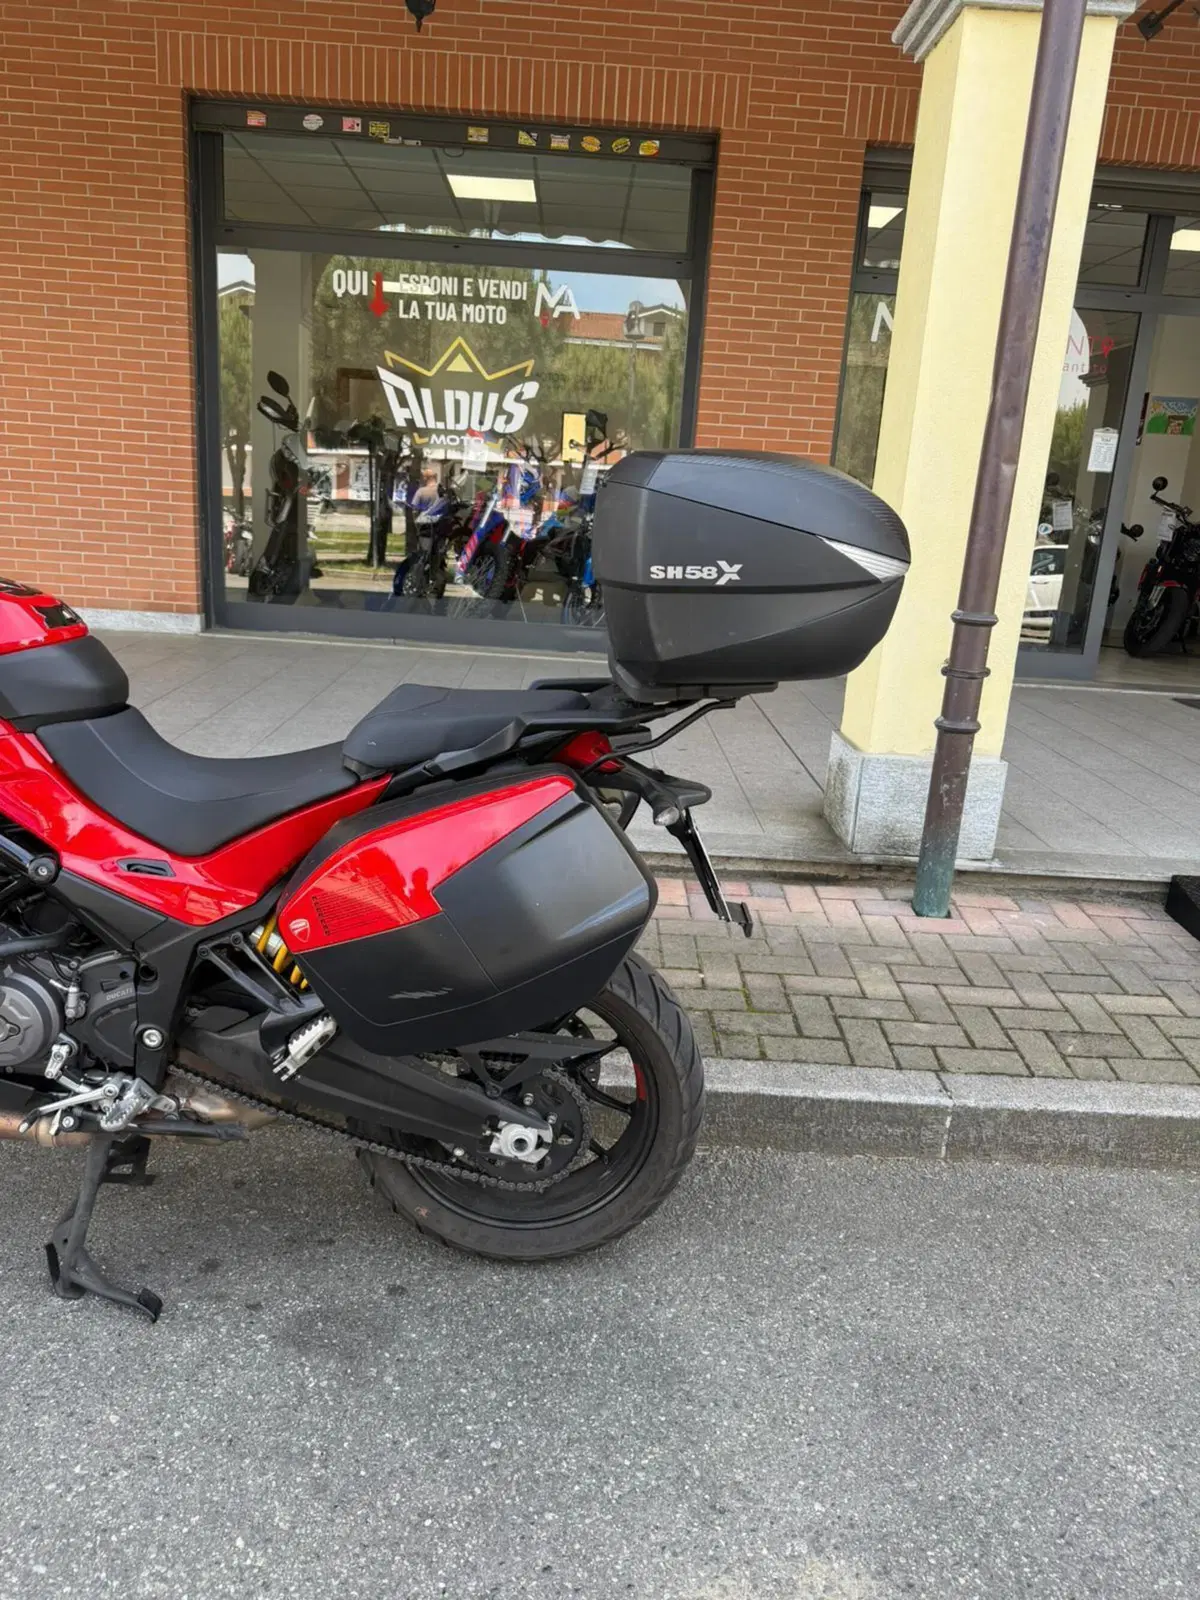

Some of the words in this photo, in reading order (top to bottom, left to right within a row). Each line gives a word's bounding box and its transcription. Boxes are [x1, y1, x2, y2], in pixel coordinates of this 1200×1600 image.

[332, 269, 368, 298] QUI
[398, 273, 459, 297] ESPONI
[462, 277, 473, 297] E
[477, 278, 528, 301] VENDI
[398, 298, 420, 320] LA
[423, 300, 458, 323] TUA
[461, 303, 507, 325] MOTO
[375, 364, 540, 433] ALDUS
[430, 434, 484, 446] MOTO
[649, 559, 744, 586] SH58X
